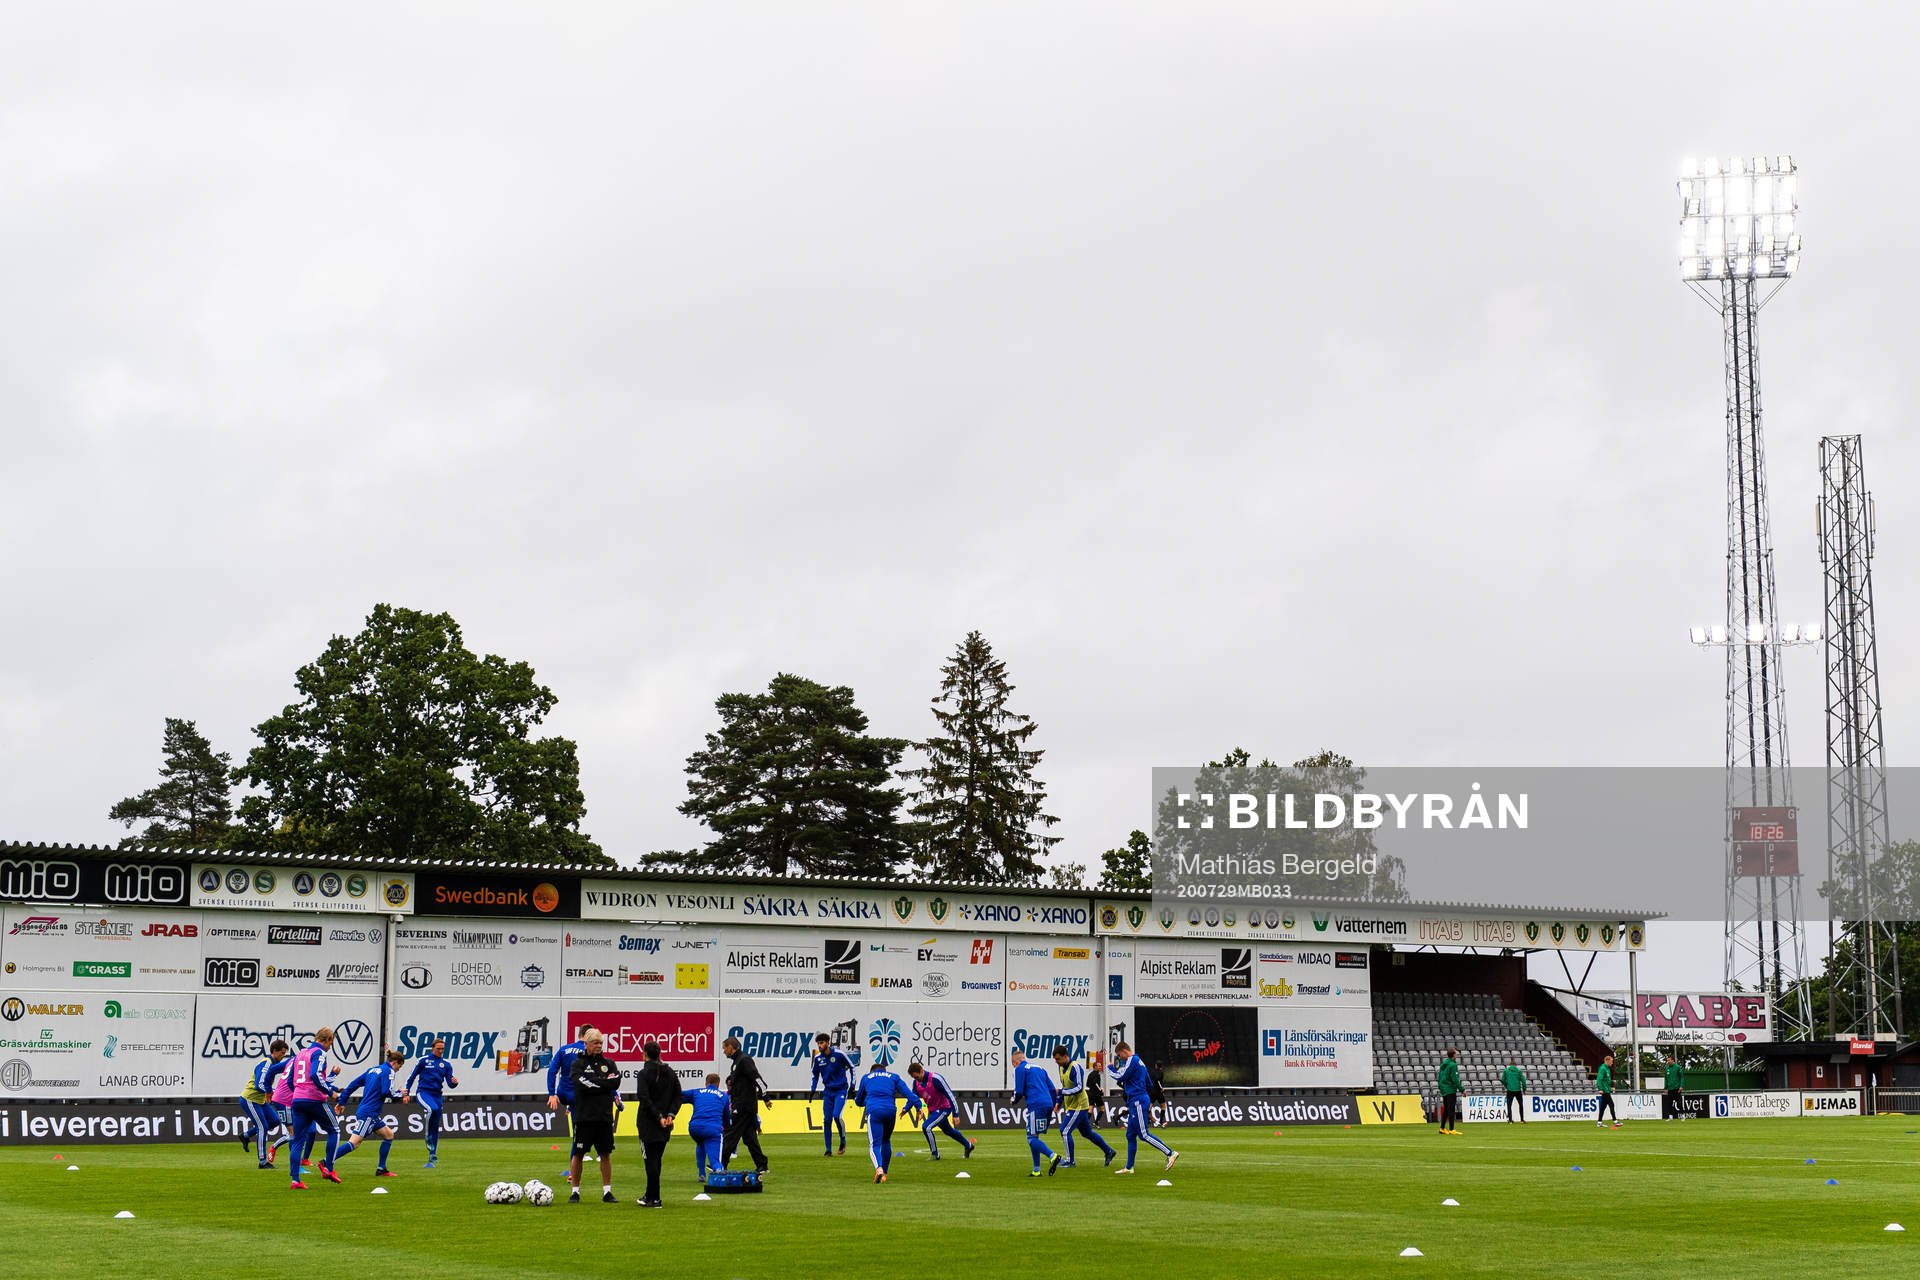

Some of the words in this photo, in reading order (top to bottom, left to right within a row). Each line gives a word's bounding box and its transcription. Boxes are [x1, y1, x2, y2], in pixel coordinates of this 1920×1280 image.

[1751, 826, 1784, 839] 18:26
[435, 886, 529, 905] Swedbank
[586, 892, 657, 908] WIDRON
[666, 895, 735, 910] VESONLI
[743, 894, 809, 917] SÄKRA
[818, 897, 881, 919] SÄKRA
[973, 904, 1021, 922] XANO
[1041, 907, 1087, 925] XANO
[141, 923, 198, 938] JRAB
[1334, 914, 1407, 934] Vätterhem
[1419, 918, 1464, 940] ITAB
[1473, 920, 1515, 943] ITAB
[211, 929, 256, 938] OPTIMERA
[270, 927, 321, 941] Tortellini
[329, 930, 366, 941] Atteviks
[395, 930, 447, 939] SEVERINS
[571, 937, 612, 947] Brandtornet
[618, 935, 662, 955] Semax
[671, 940, 713, 949] JUNET
[918, 949, 935, 961] EY
[1008, 948, 1049, 958] teamolmed
[1058, 950, 1087, 959] Transab
[1297, 953, 1332, 966] MIDAQ
[726, 951, 767, 970] Alpist
[769, 953, 819, 969] Reklam
[22, 964, 55, 974] Holmgrens
[276, 967, 321, 979] ASPLUNDS
[451, 962, 492, 974] LIDHED
[565, 969, 614, 978] STRAND
[1140, 960, 1172, 977] Alpist
[1174, 961, 1217, 976] Reklam
[451, 973, 503, 986] BOSTRÖM
[878, 977, 913, 990] JEMAB
[1052, 977, 1091, 987] WETTER
[961, 981, 1003, 992] BYGGINVEST
[1051, 986, 1089, 998] HÄLSAN
[1259, 978, 1293, 998] Sandhs
[1296, 984, 1331, 996] Tingstad
[1140, 992, 1188, 1000] PROFILKLÄDER
[26, 1003, 84, 1016] WALKER
[1636, 994, 1766, 1029] KABE
[912, 1021, 1001, 1046] Söderberg
[1284, 1029, 1369, 1045] Länsförsäkringar
[0, 1040, 92, 1049] Gräsvårdsmaskiner
[120, 1043, 185, 1051] STEELCENTER
[397, 1026, 500, 1069] Semax
[1012, 1028, 1088, 1064] Semax
[1173, 1040, 1207, 1049] TELE
[1284, 1043, 1336, 1059] Jönköping
[927, 1046, 999, 1066] Partners
[1284, 1060, 1300, 1068] Bank
[295, 1059, 307, 1083] 3
[99, 1075, 138, 1087] LANAB
[1627, 1095, 1656, 1110] AQUA
[1729, 1095, 1753, 1108] TMG
[1755, 1094, 1791, 1112] Tabergs
[1814, 1098, 1857, 1111] JEMAB
[963, 1101, 984, 1125] Vi
[1248, 1100, 1350, 1122] situationer
[1372, 1101, 1396, 1122] W
[21, 1110, 165, 1137] levererar
[174, 1110, 182, 1136] i
